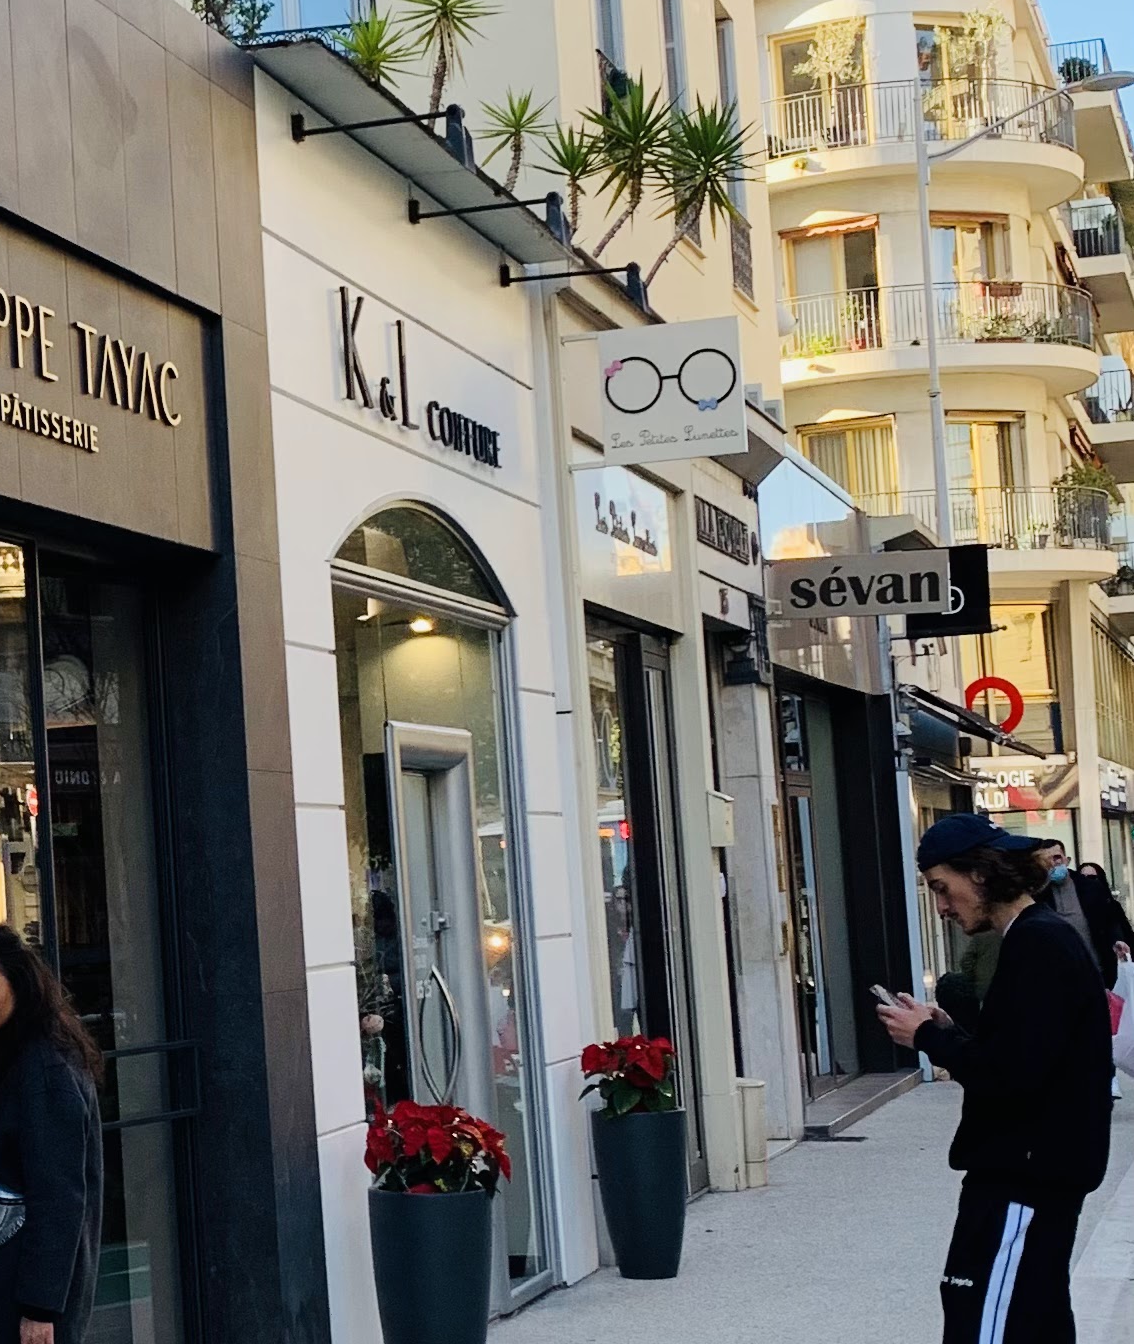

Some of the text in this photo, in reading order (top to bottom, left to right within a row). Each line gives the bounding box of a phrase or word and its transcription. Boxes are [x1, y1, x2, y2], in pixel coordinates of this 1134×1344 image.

[72, 321, 182, 427] TAYAC
[611, 432, 635, 449] Les
[683, 425, 739, 442] Lunettes
[790, 566, 941, 610] sévan
